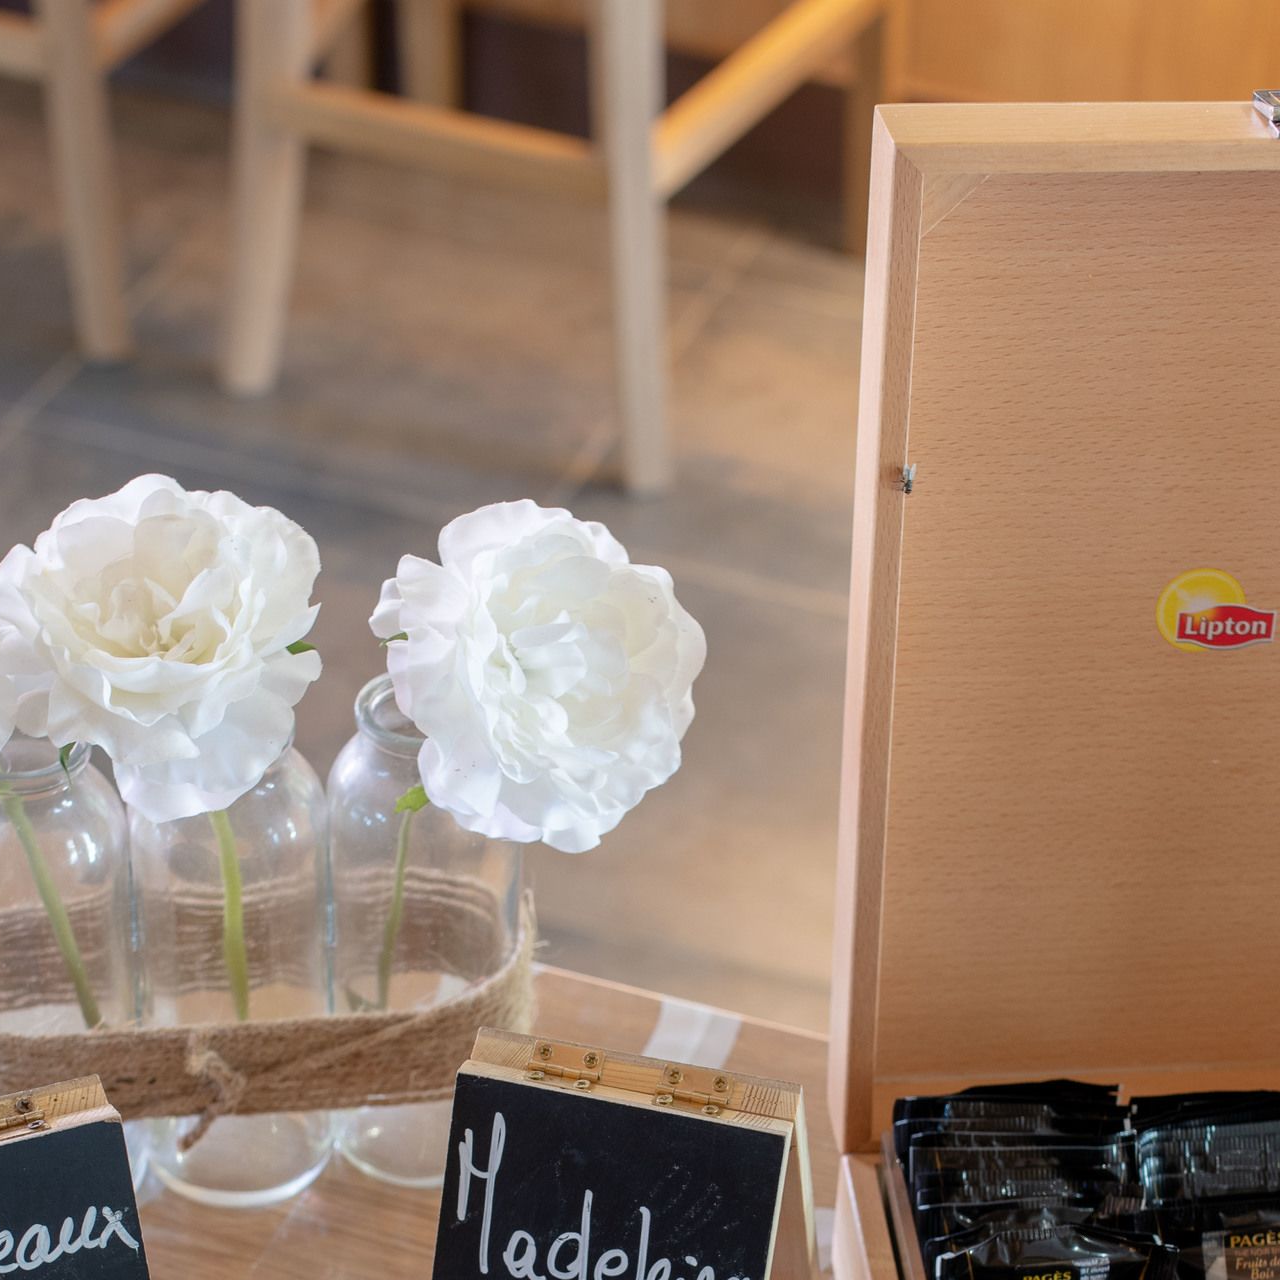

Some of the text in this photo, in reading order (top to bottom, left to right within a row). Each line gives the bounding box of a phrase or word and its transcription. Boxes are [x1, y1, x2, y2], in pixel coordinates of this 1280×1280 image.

[1184, 616, 1267, 640] Lipton
[1235, 1256, 1268, 1271] Fruits
[1250, 1269, 1275, 1280] Bois
